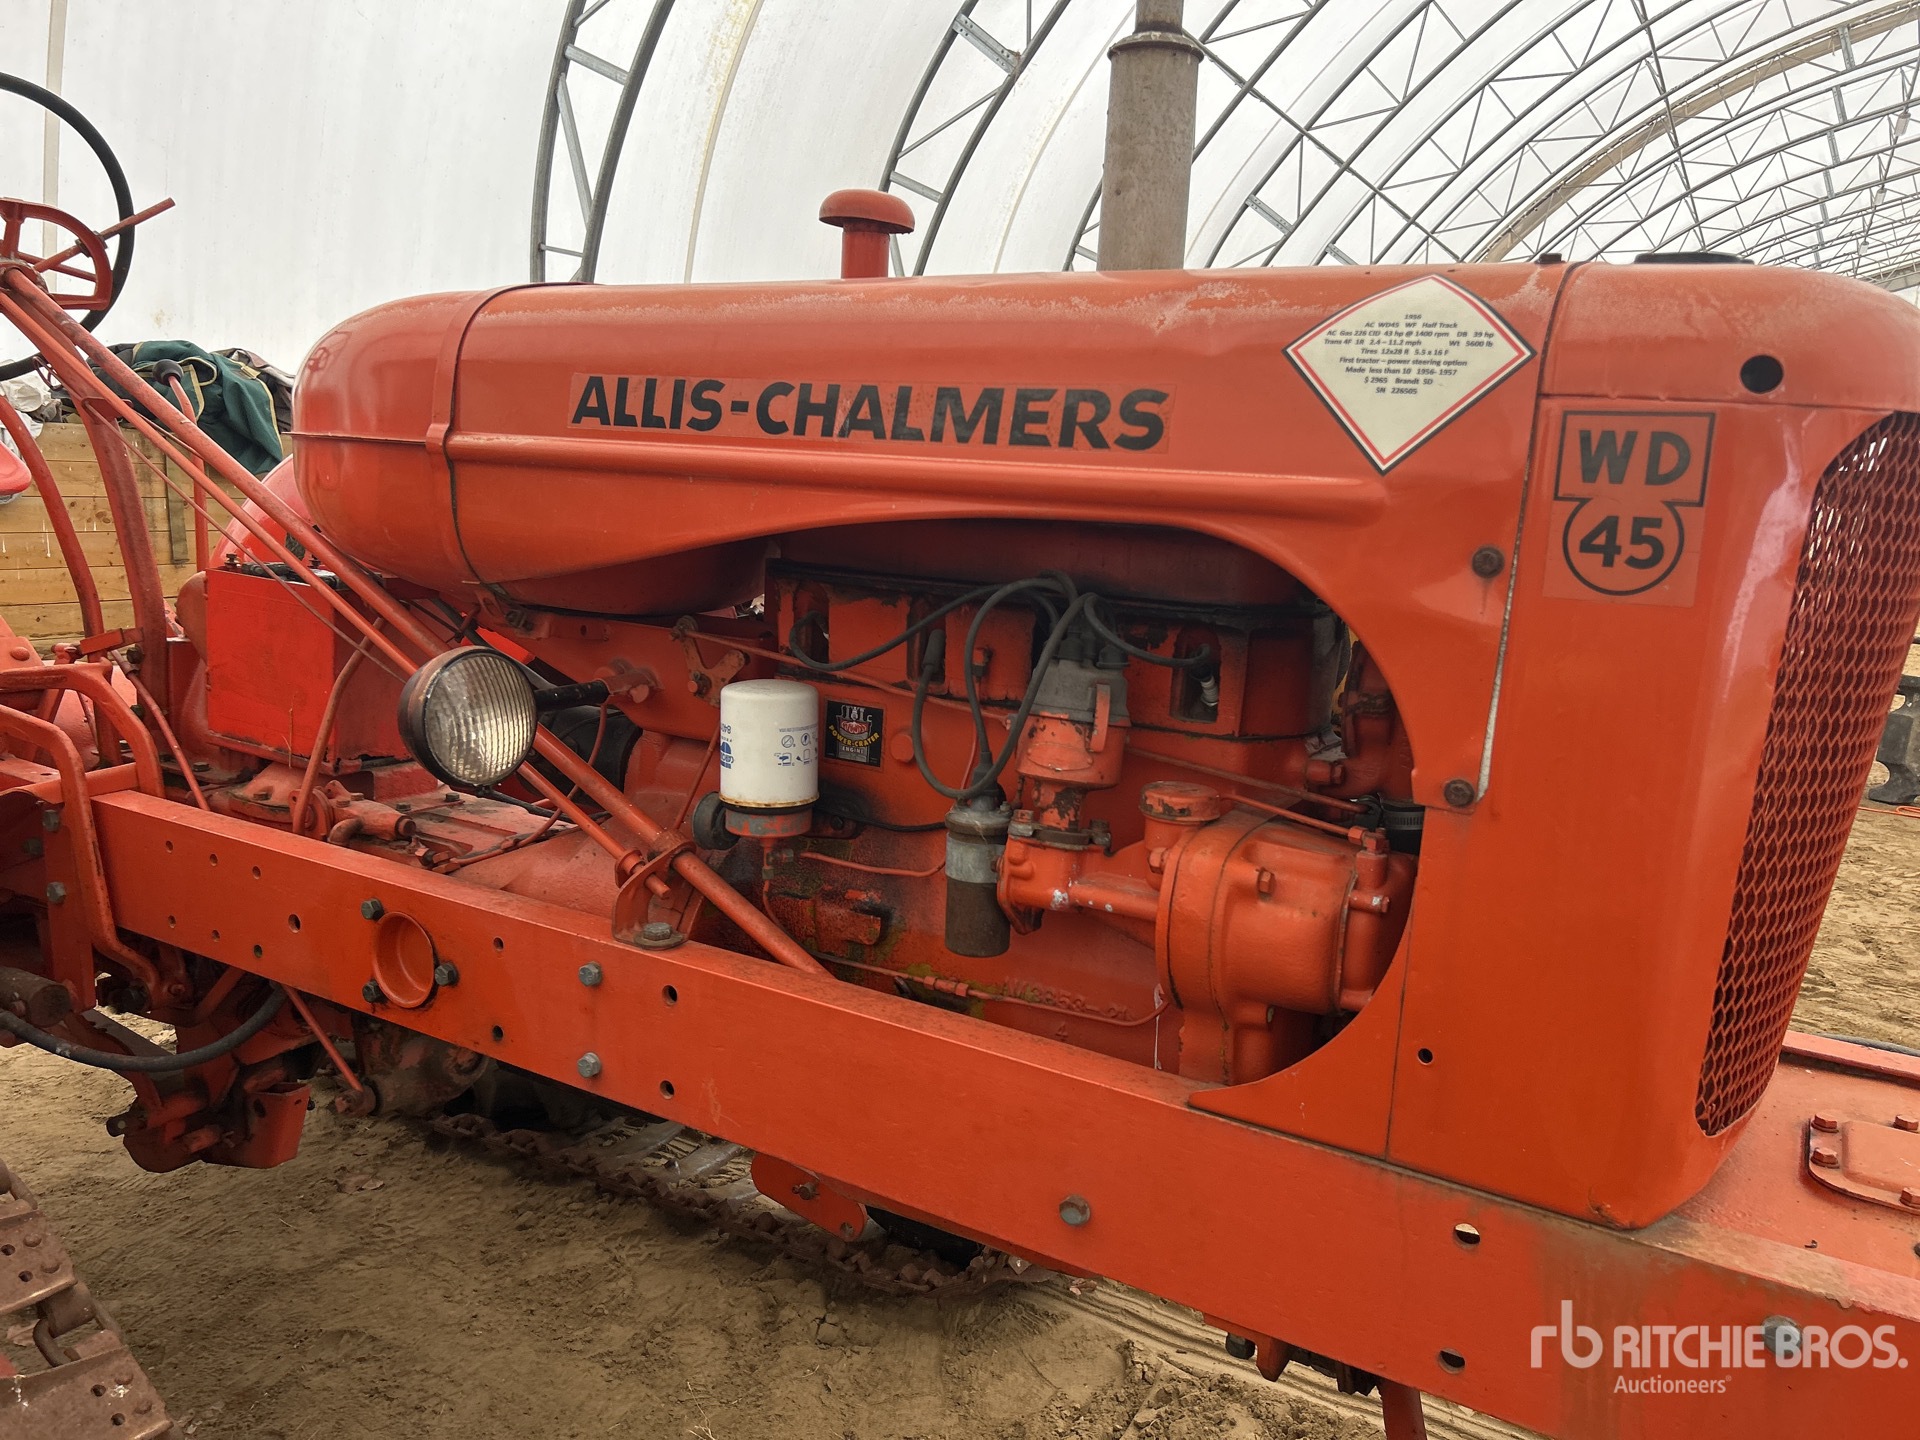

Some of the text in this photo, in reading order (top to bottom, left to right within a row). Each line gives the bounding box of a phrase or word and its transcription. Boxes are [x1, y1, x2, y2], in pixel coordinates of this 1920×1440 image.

[1412, 359, 1441, 367] steering
[1364, 376, 1369, 384] $
[571, 375, 1170, 451] ALLIS-CHALMERS
[1579, 430, 1691, 486] WD
[1579, 515, 1665, 570] 45
[829, 725, 880, 747] POWER-CRATER
[842, 746, 864, 754] ENGINE
